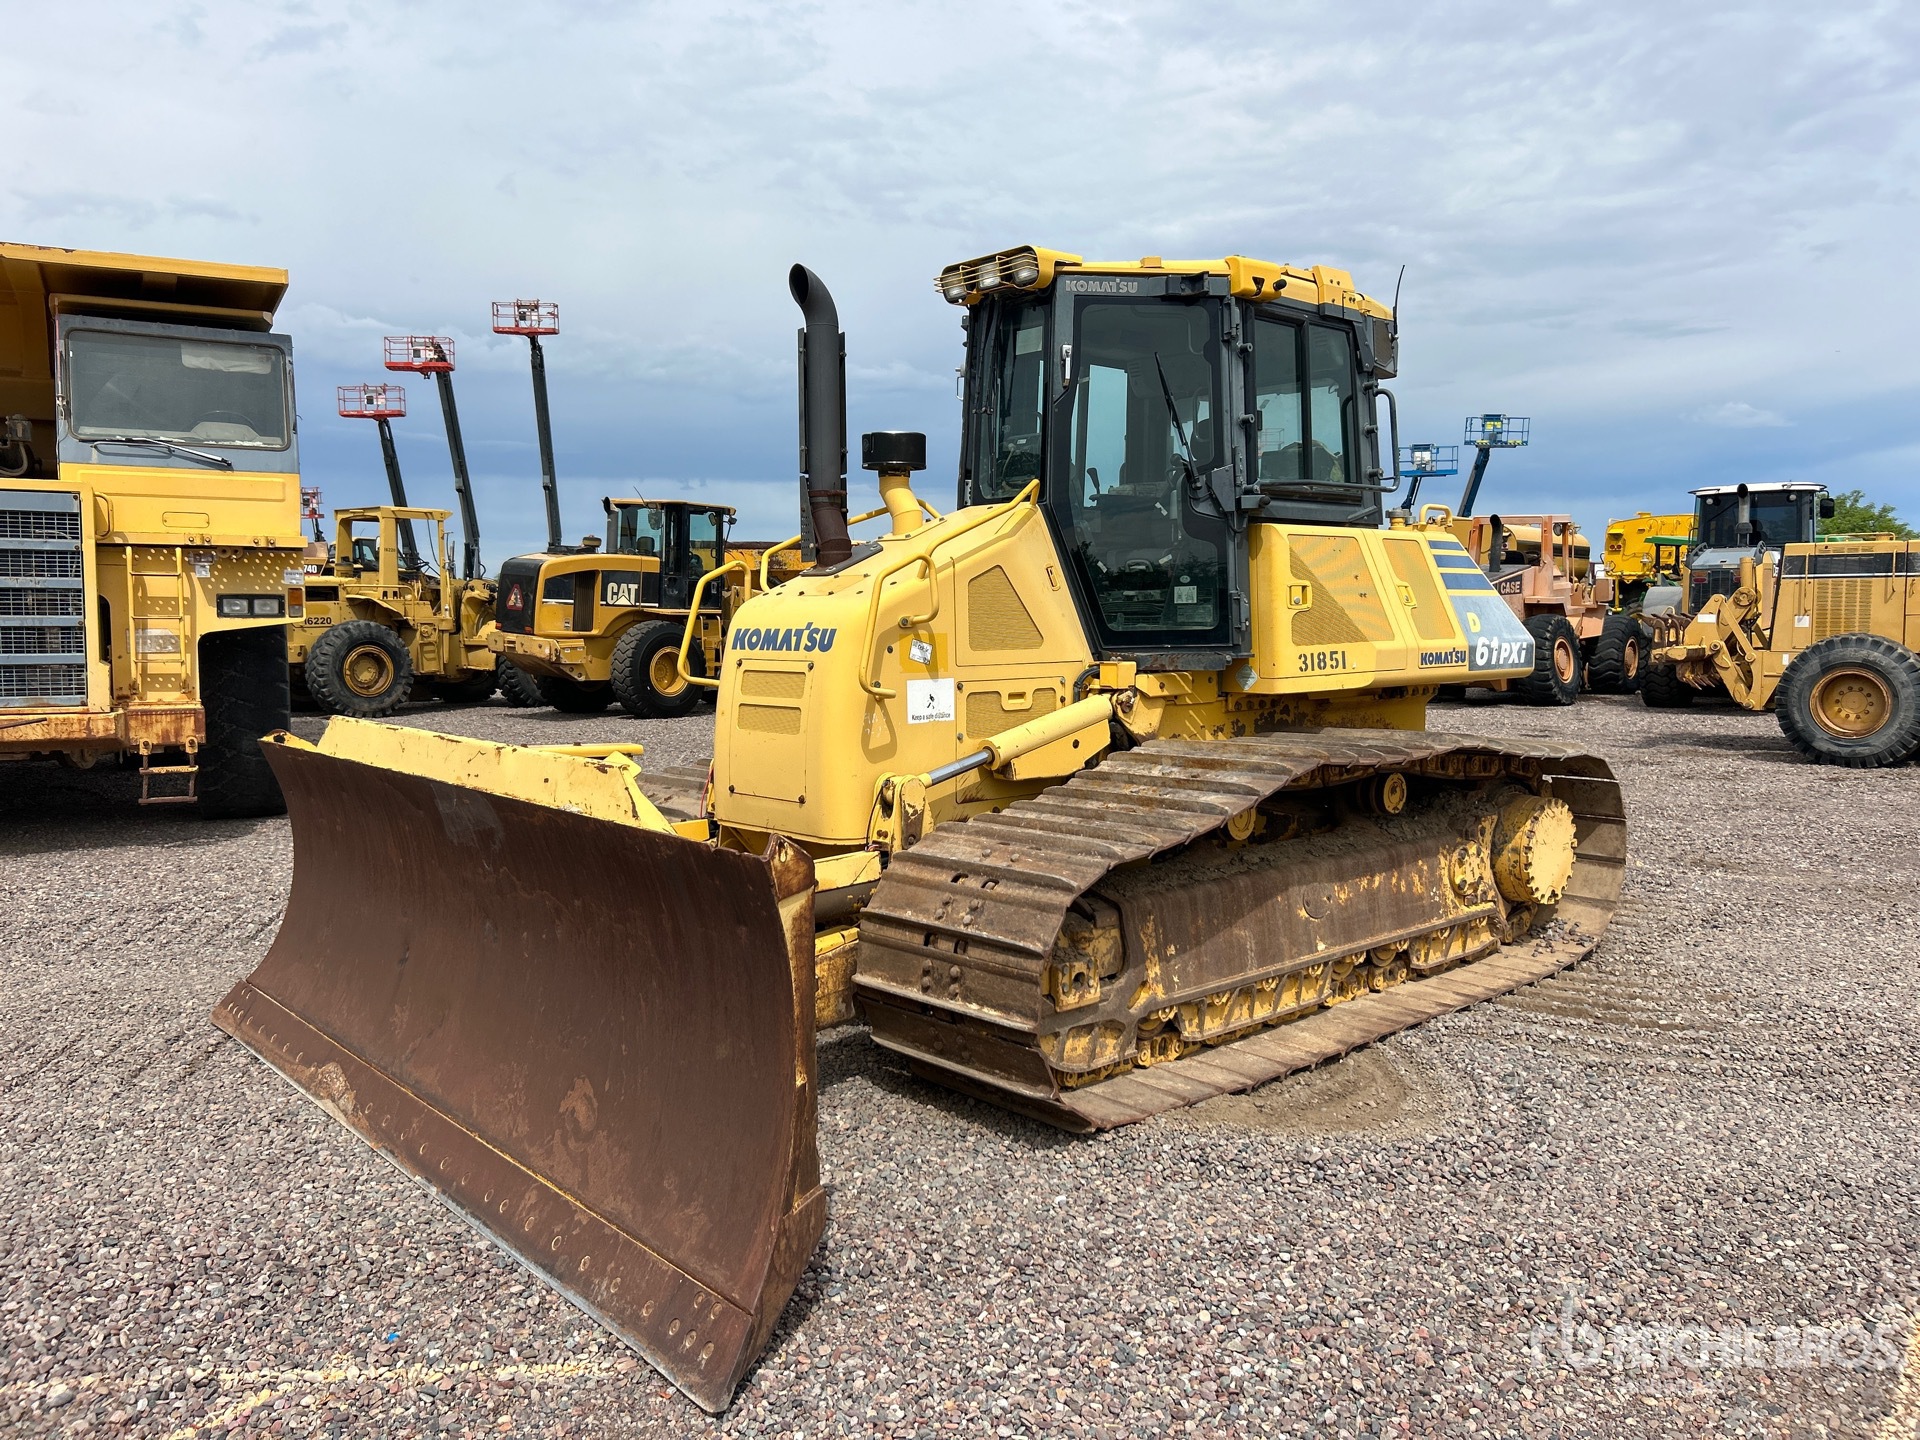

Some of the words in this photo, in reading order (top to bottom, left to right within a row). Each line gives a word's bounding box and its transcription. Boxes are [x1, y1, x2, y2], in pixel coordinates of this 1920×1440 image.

[1065, 278, 1138, 294] KOMATSU
[304, 564, 318, 574] 740
[607, 582, 639, 606] CAT
[1500, 581, 1521, 594] CASE
[1466, 612, 1481, 633] D
[731, 621, 838, 653] KOMATSU
[1298, 651, 1347, 672] 31851
[1421, 647, 1466, 665] KOMATSU
[1475, 636, 1527, 666] 61PXi
